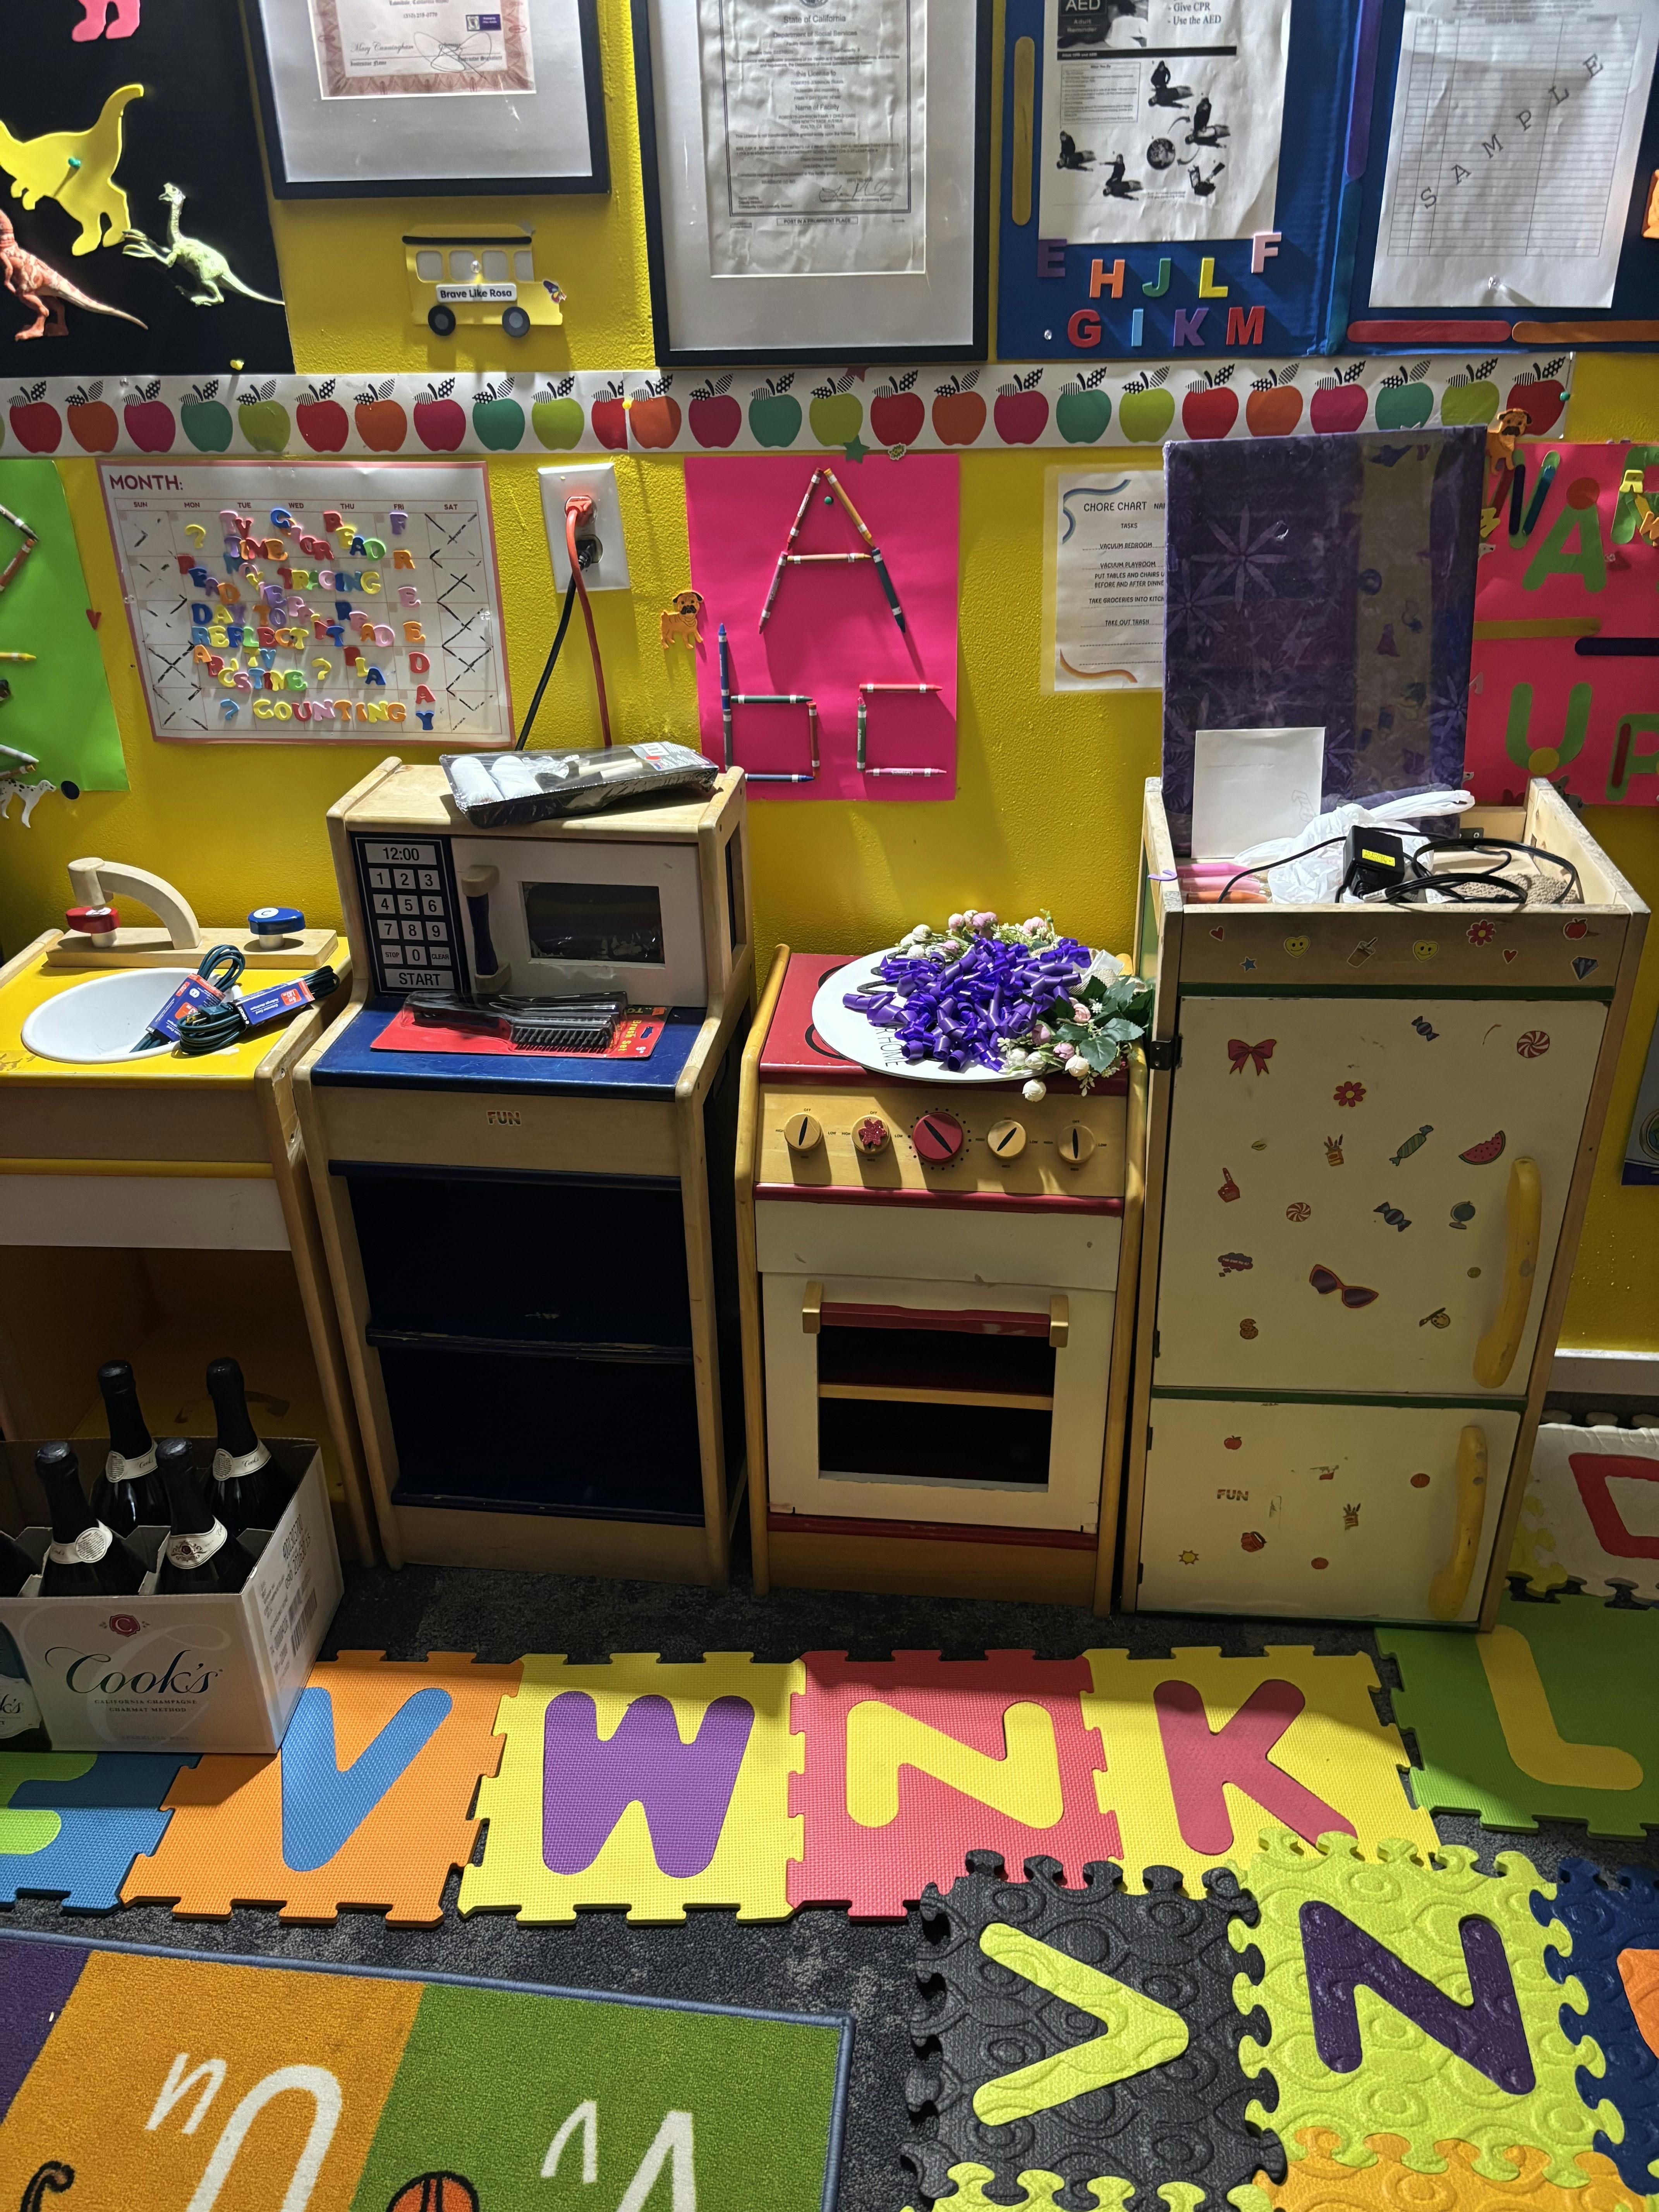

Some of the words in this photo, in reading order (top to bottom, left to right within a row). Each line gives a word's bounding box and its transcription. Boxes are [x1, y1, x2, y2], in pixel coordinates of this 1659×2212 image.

[1065, 0, 1100, 11] AED
[1173, 3, 1191, 12] Give
[1194, 2, 1210, 12] CPR
[1173, 16, 1187, 25] Use
[1189, 16, 1200, 25] the
[1203, 15, 1221, 24] AED
[350, 42, 371, 55] Mary
[373, 41, 414, 54] Cunningham
[1037, 239, 1067, 278] E
[1251, 232, 1281, 273] F
[1089, 259, 1125, 298] H
[1142, 258, 1171, 297] J
[1199, 257, 1228, 298] L
[441, 289, 466, 299] Brave
[469, 288, 487, 299] Like
[489, 289, 512, 298] Rosa
[1068, 309, 1101, 347] G
[1173, 308, 1209, 347] K
[1226, 306, 1265, 345] M
[110, 475, 183, 490] MONTH:
[1084, 502, 1115, 512] CHORE
[1118, 501, 1147, 511] CHART
[323, 510, 386, 561] READ
[191, 604, 247, 624] DAY
[252, 605, 287, 627] TO
[191, 625, 309, 650] REFLECT
[248, 668, 308, 691] TIME
[253, 698, 407, 723] COUNTING
[382, 847, 420, 861] 12:00
[377, 872, 383, 885] 1
[400, 873, 410, 886] 2
[424, 874, 433, 887] 3
[381, 898, 390, 910] 4
[404, 899, 413, 912] 5
[428, 900, 437, 912] 6
[384, 923, 392, 936] 7
[409, 924, 417, 937] 8
[431, 925, 441, 938] 9
[412, 949, 420, 961] 0
[399, 972, 440, 986] START
[625, 1020, 642, 1038] Brush
[618, 1040, 632, 1051] Set
[486, 1111, 522, 1126] FUN
[1216, 1488, 1249, 1502] FUN
[45, 1646, 218, 1694] Cook's
[1152, 1678, 1357, 1855] K
[281, 1687, 452, 1872] V
[542, 1690, 755, 1878] W
